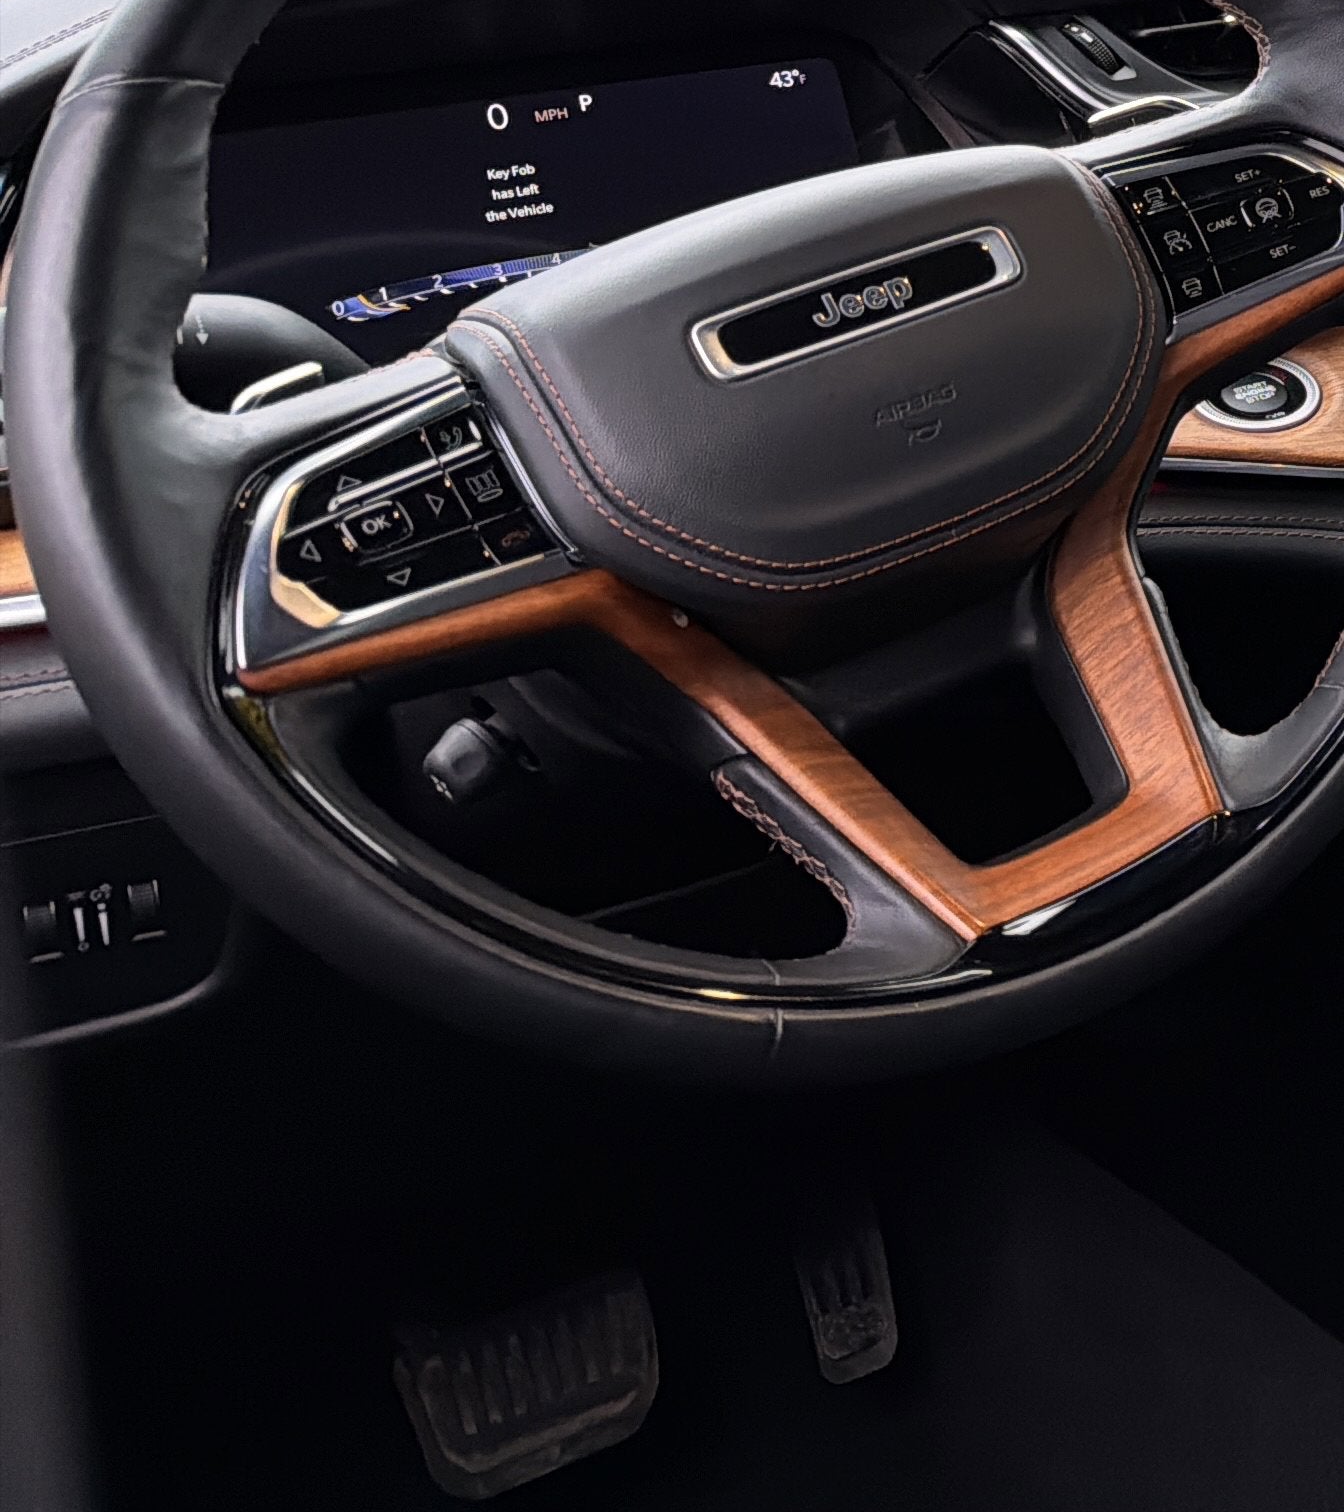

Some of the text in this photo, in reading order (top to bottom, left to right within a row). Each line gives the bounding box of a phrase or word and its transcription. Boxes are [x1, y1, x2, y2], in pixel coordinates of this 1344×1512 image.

[486, 93, 593, 130] 0 MPH P
[486, 162, 535, 183] Key Fob
[1234, 168, 1262, 183] SET+
[491, 181, 540, 200] has Left
[1309, 186, 1329, 199] RES
[485, 200, 554, 223] the Vehicle
[1206, 215, 1238, 233] CANC
[432, 273, 443, 289] 2
[812, 276, 913, 328] Jeep
[876, 383, 958, 427] AIRBAG
[361, 514, 392, 535] OK
